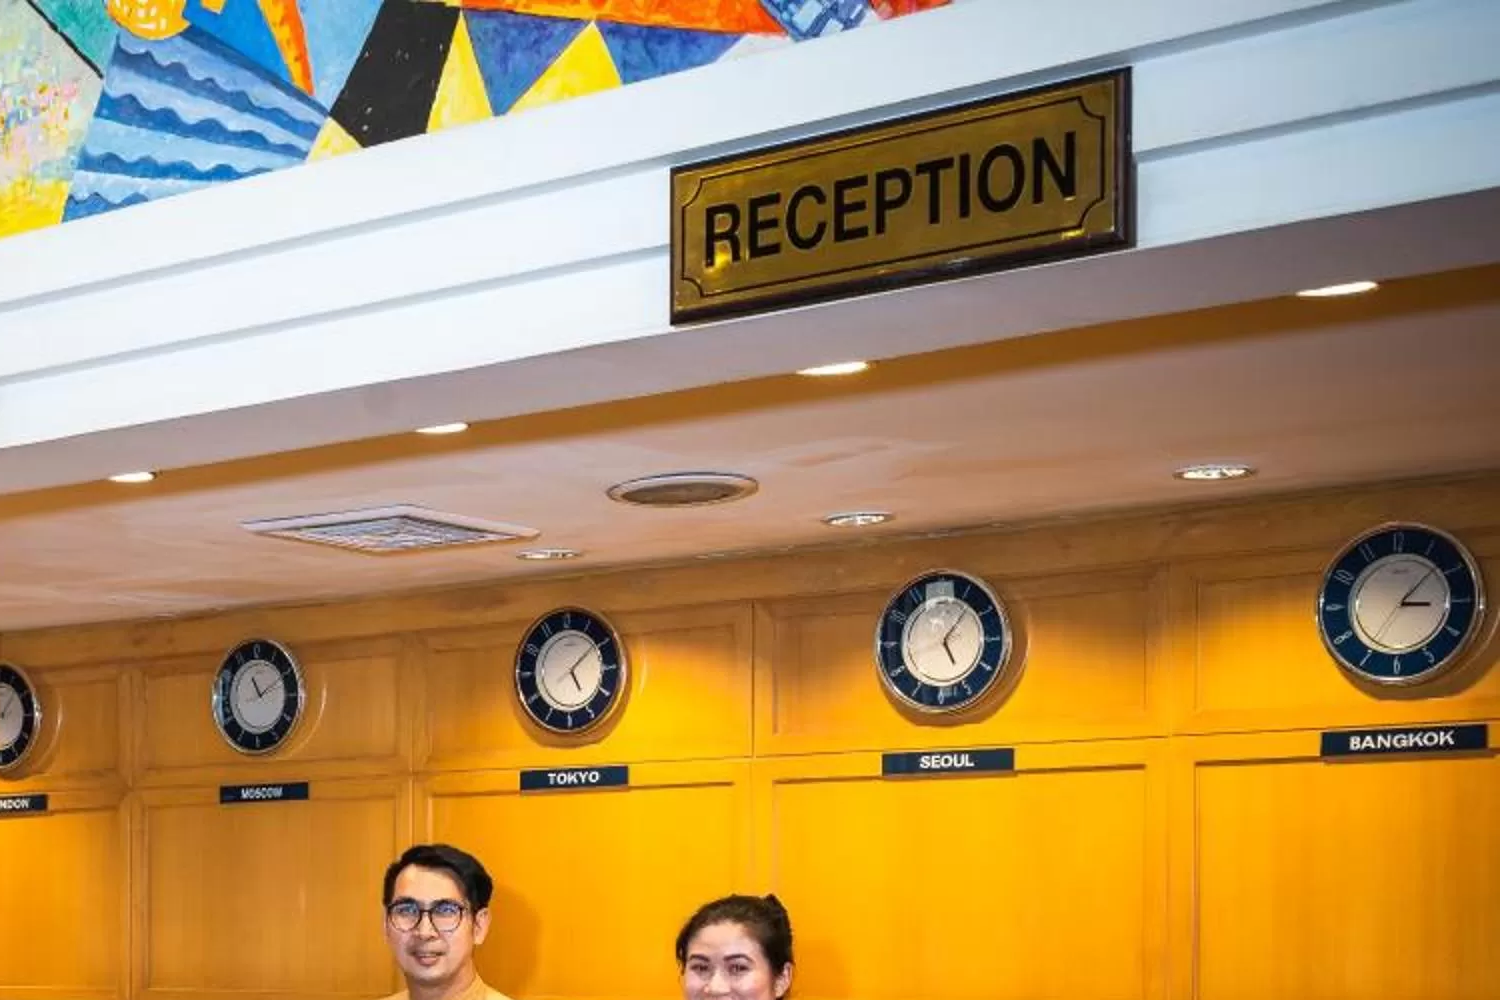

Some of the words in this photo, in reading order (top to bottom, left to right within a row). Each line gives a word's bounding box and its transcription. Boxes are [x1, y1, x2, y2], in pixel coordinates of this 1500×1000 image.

[705, 131, 1077, 269] RECEPTION
[1349, 730, 1455, 751] BANGKOK
[919, 753, 975, 769] SEOUL
[547, 770, 601, 786] TOKYO
[241, 786, 283, 799] MOSCOW
